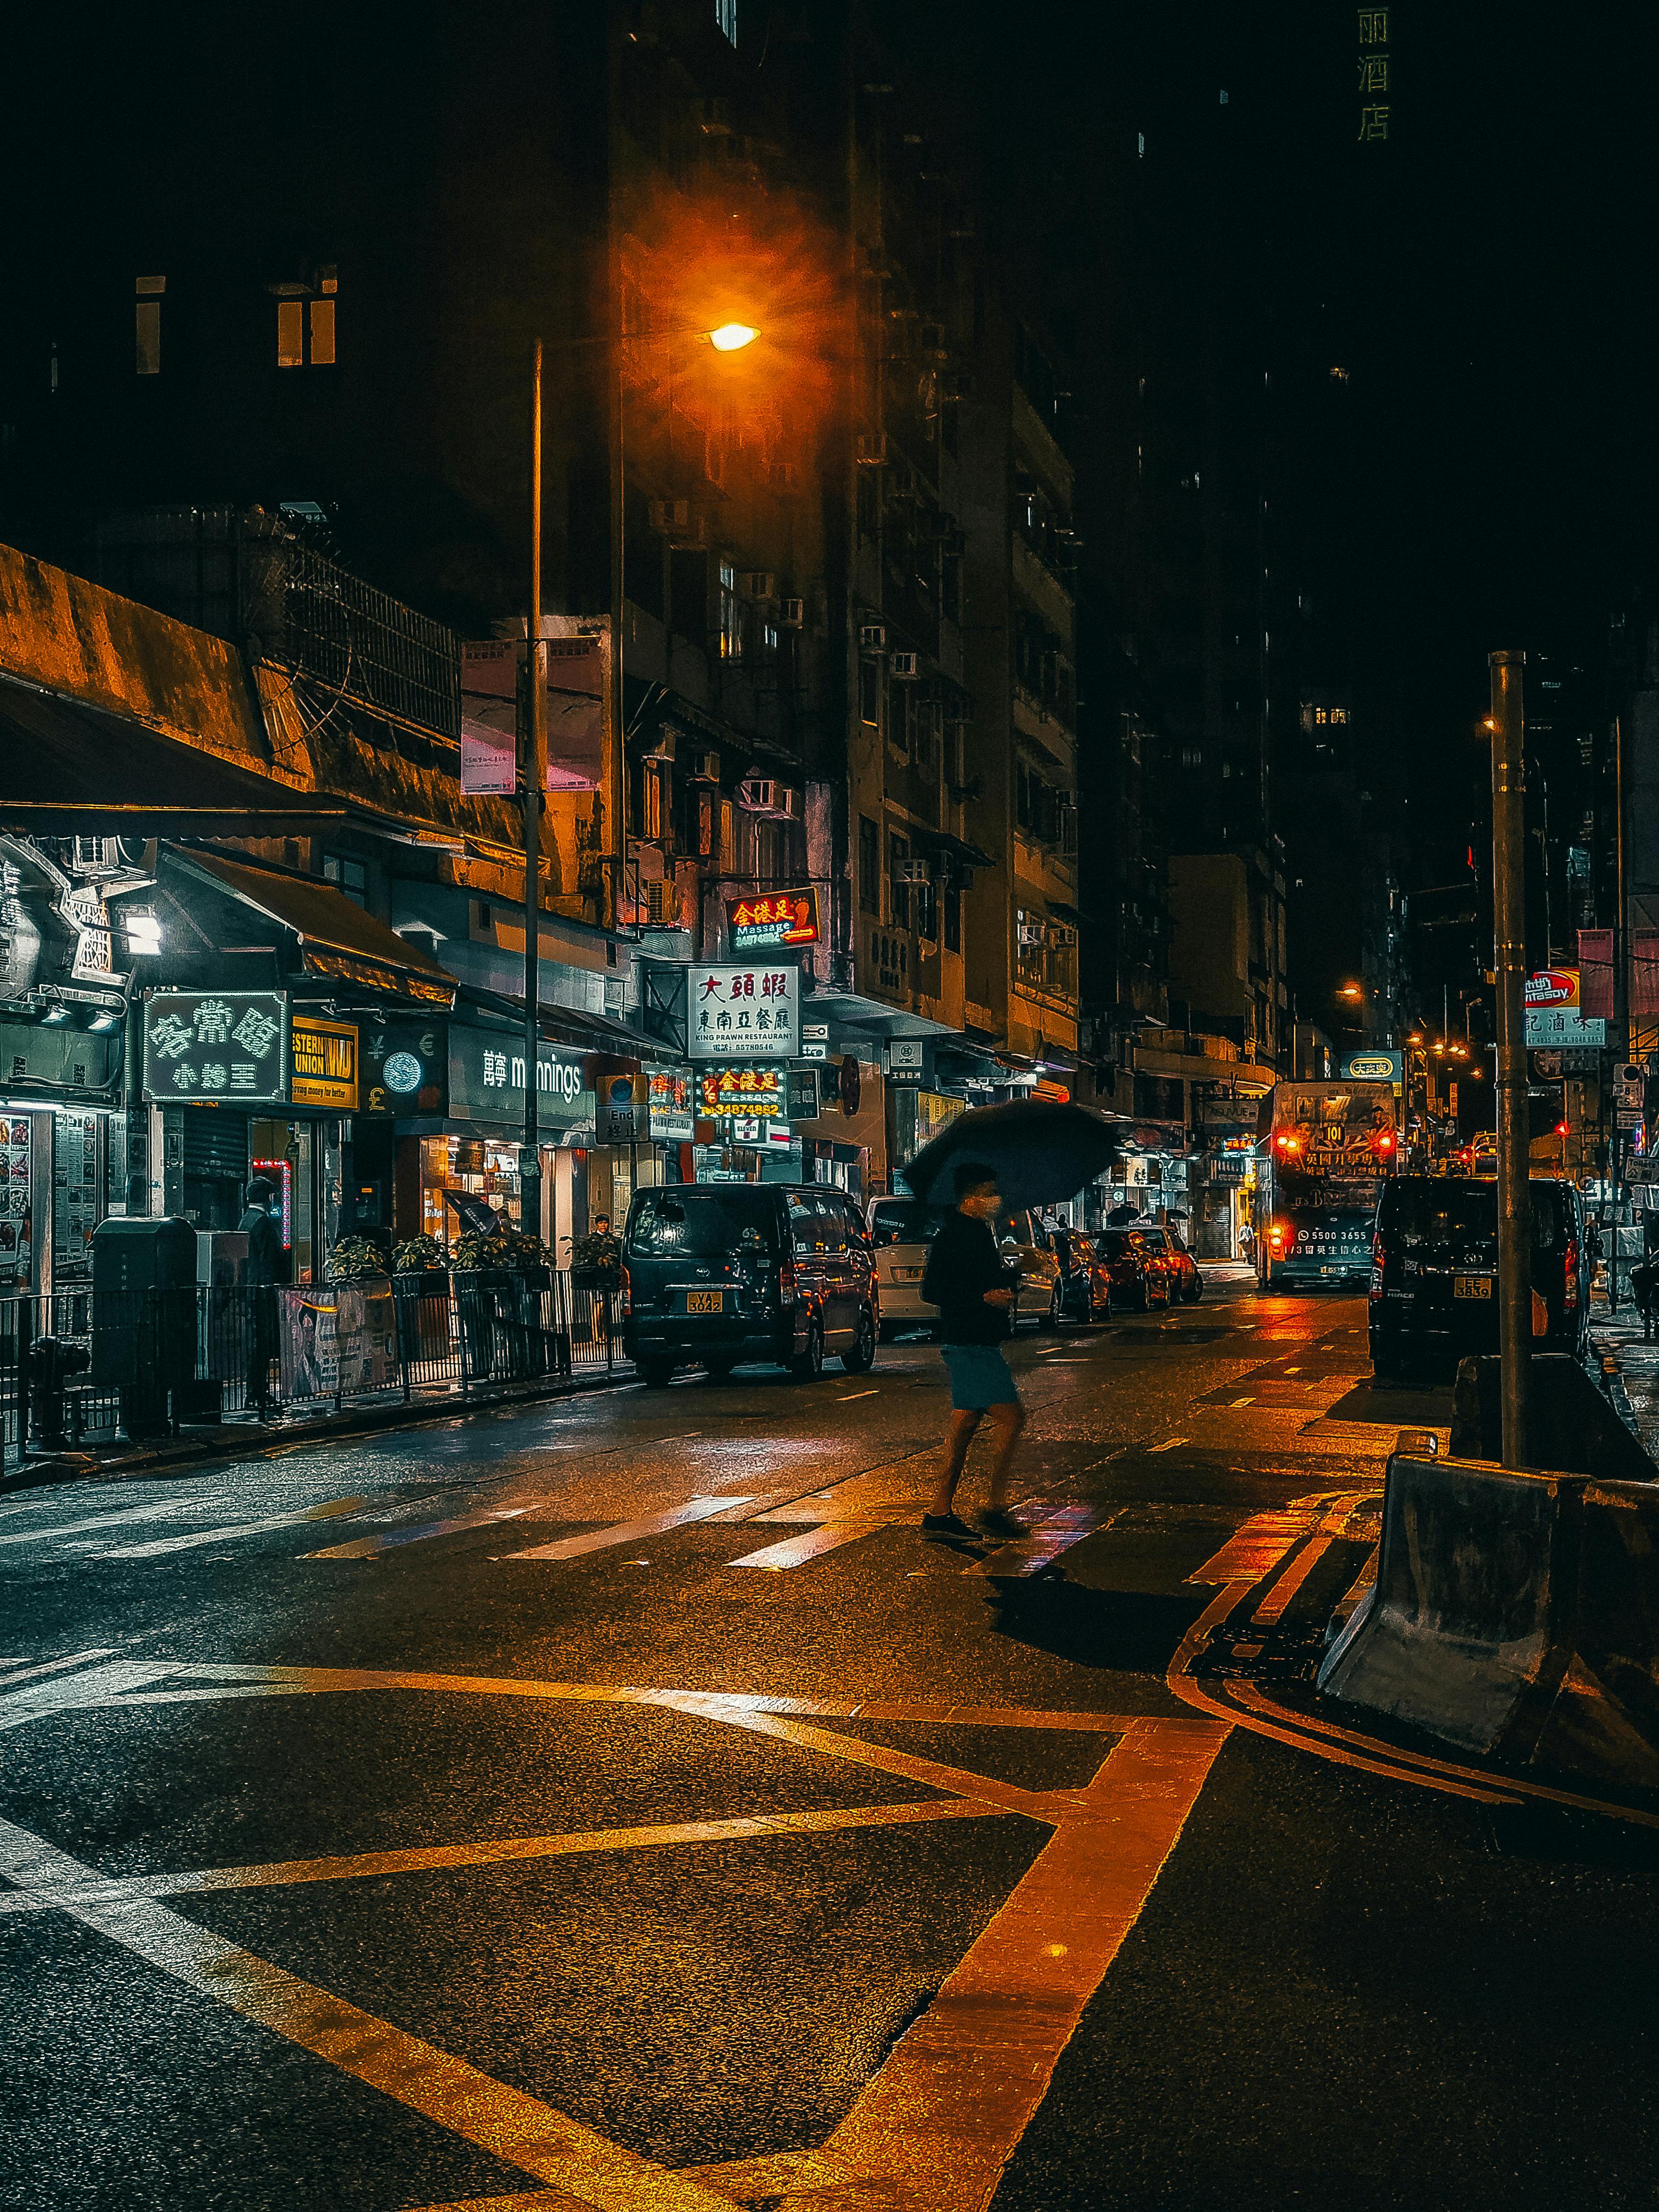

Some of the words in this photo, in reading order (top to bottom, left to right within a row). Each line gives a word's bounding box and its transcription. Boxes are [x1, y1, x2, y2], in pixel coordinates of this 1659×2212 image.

[733, 899, 795, 927] 金港足
[737, 922, 791, 936] Massage
[698, 972, 792, 1004] 大頭蝦
[697, 1007, 793, 1032] 東南亞餐廳
[292, 1033, 324, 1055] STERN
[735, 1042, 774, 1052] 55780546
[295, 1053, 325, 1075] UNION
[483, 1049, 506, 1088] 萬寧
[511, 1053, 580, 1104] mnnings
[611, 1109, 634, 1121] End
[606, 1124, 639, 1138] 終止
[1327, 1126, 1341, 1141] 101
[697, 1293, 713, 1304] VA
[1456, 1287, 1490, 1297] 3839
[689, 1302, 721, 1312] 3042
